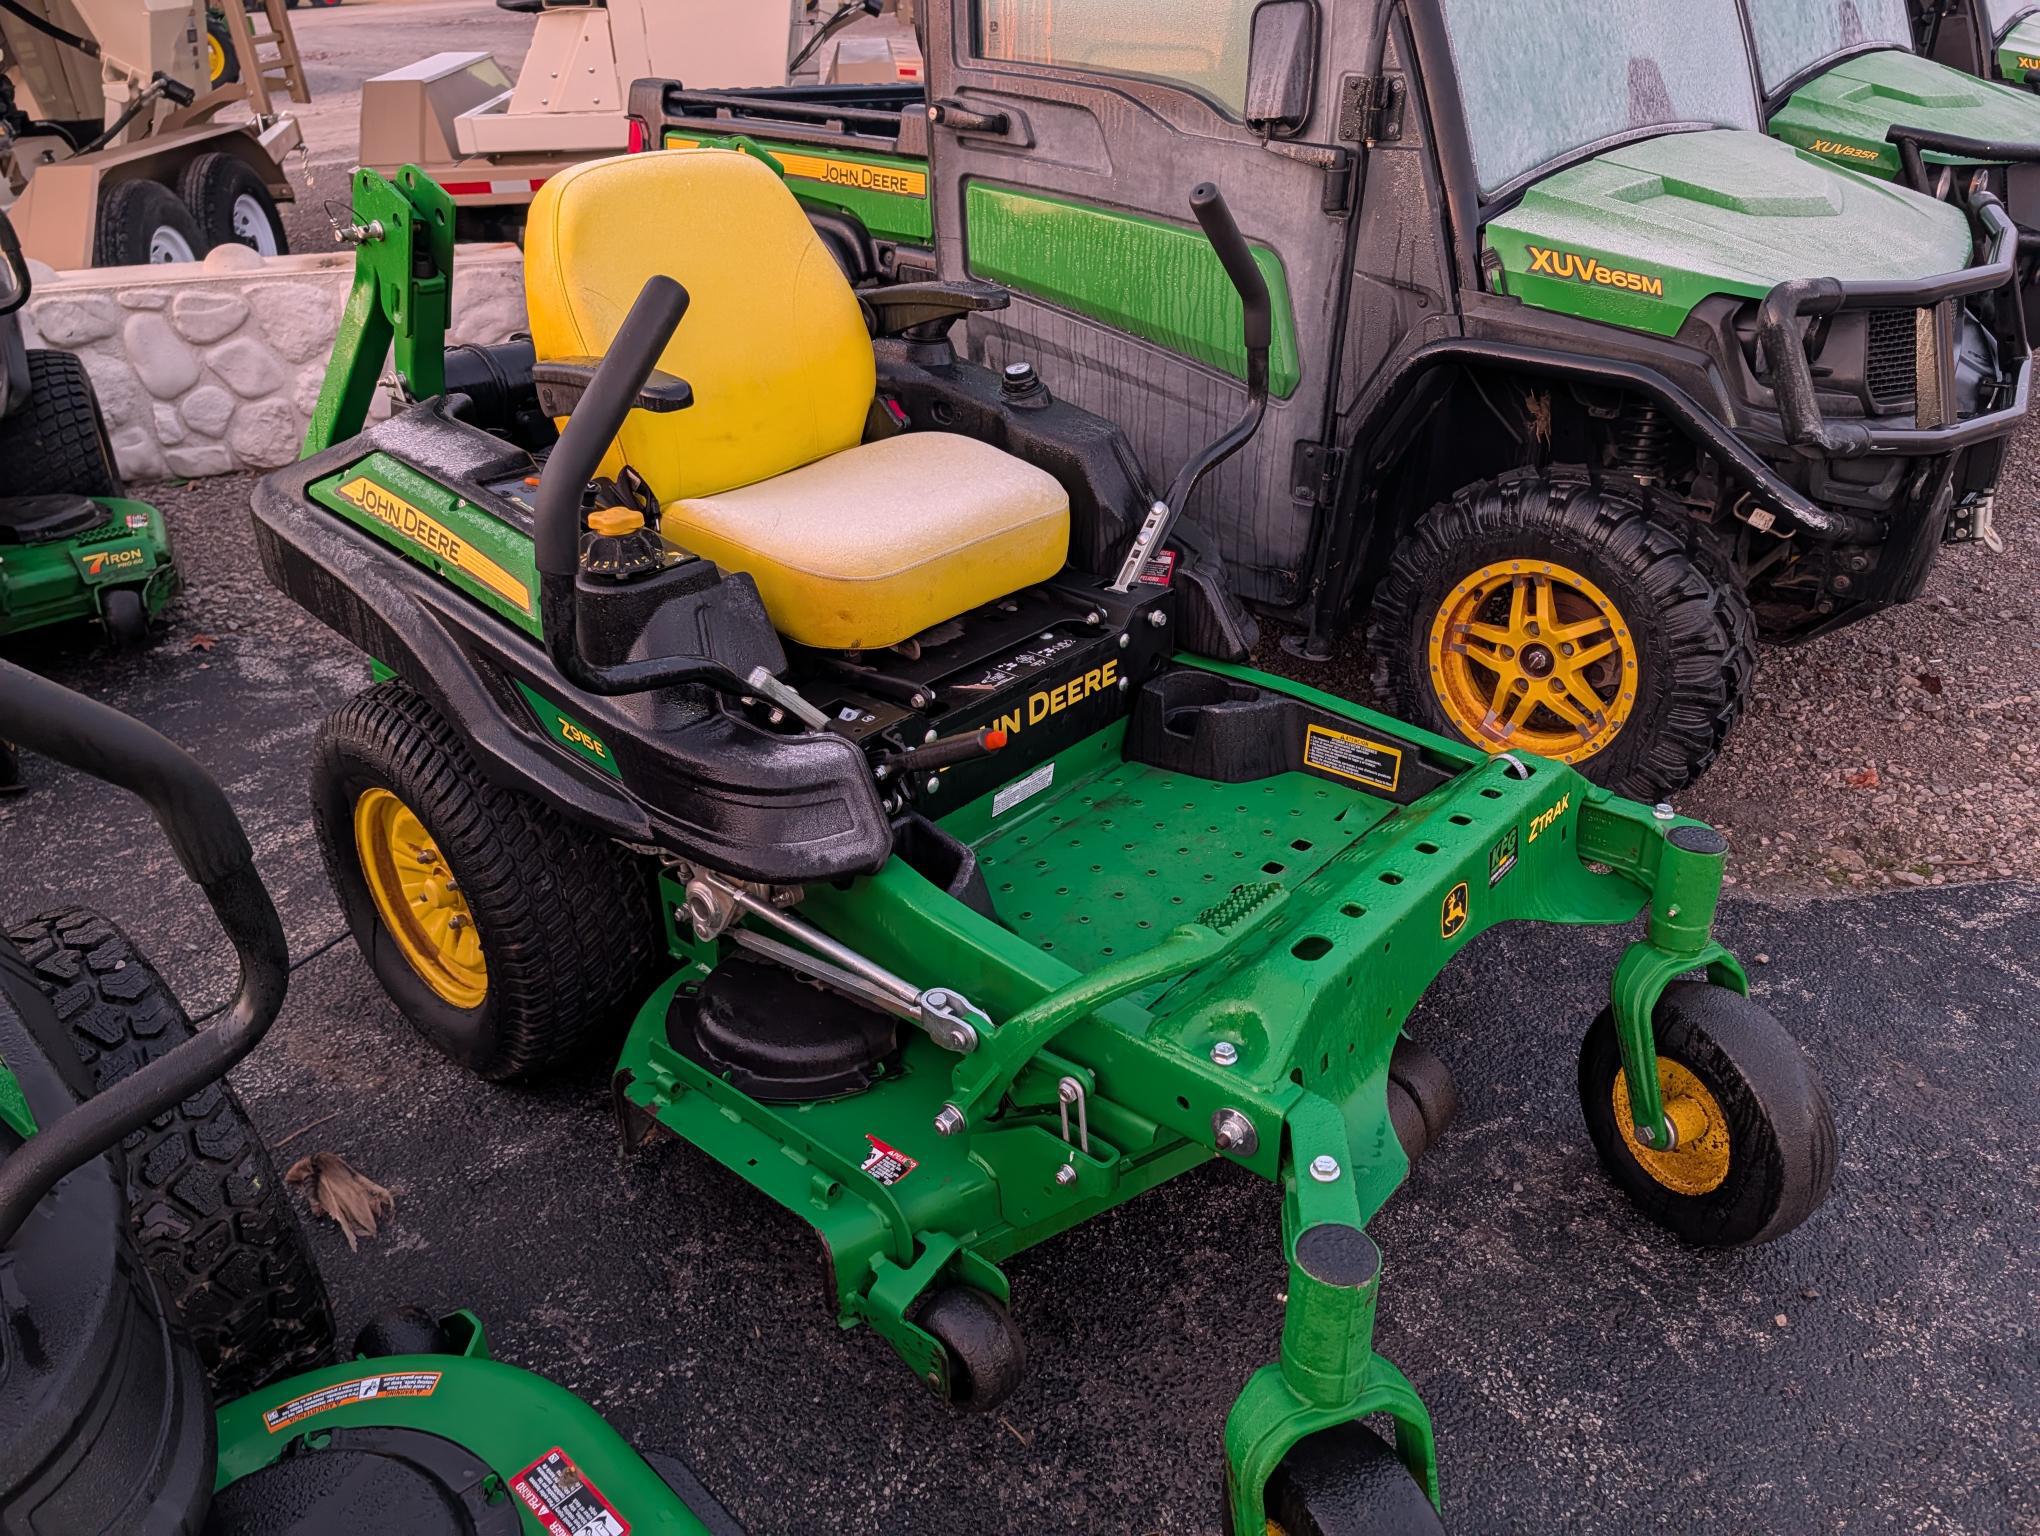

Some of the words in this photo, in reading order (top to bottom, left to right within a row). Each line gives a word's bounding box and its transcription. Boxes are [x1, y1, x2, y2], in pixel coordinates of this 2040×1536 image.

[2017, 55, 2040, 71] XU
[1807, 138, 1879, 161] XUV835R
[822, 163, 858, 184] JOHN
[862, 169, 908, 192] DEERE
[1529, 247, 1663, 296] XUV865M
[355, 482, 400, 524] JOHN
[402, 508, 461, 562] DEERE
[1028, 658, 1118, 726] DEERE
[557, 716, 606, 758] Z915E
[1527, 792, 1570, 844] ZTRAK
[1491, 829, 1517, 869] KFG
[515, 1481, 541, 1510] PELIGRO
